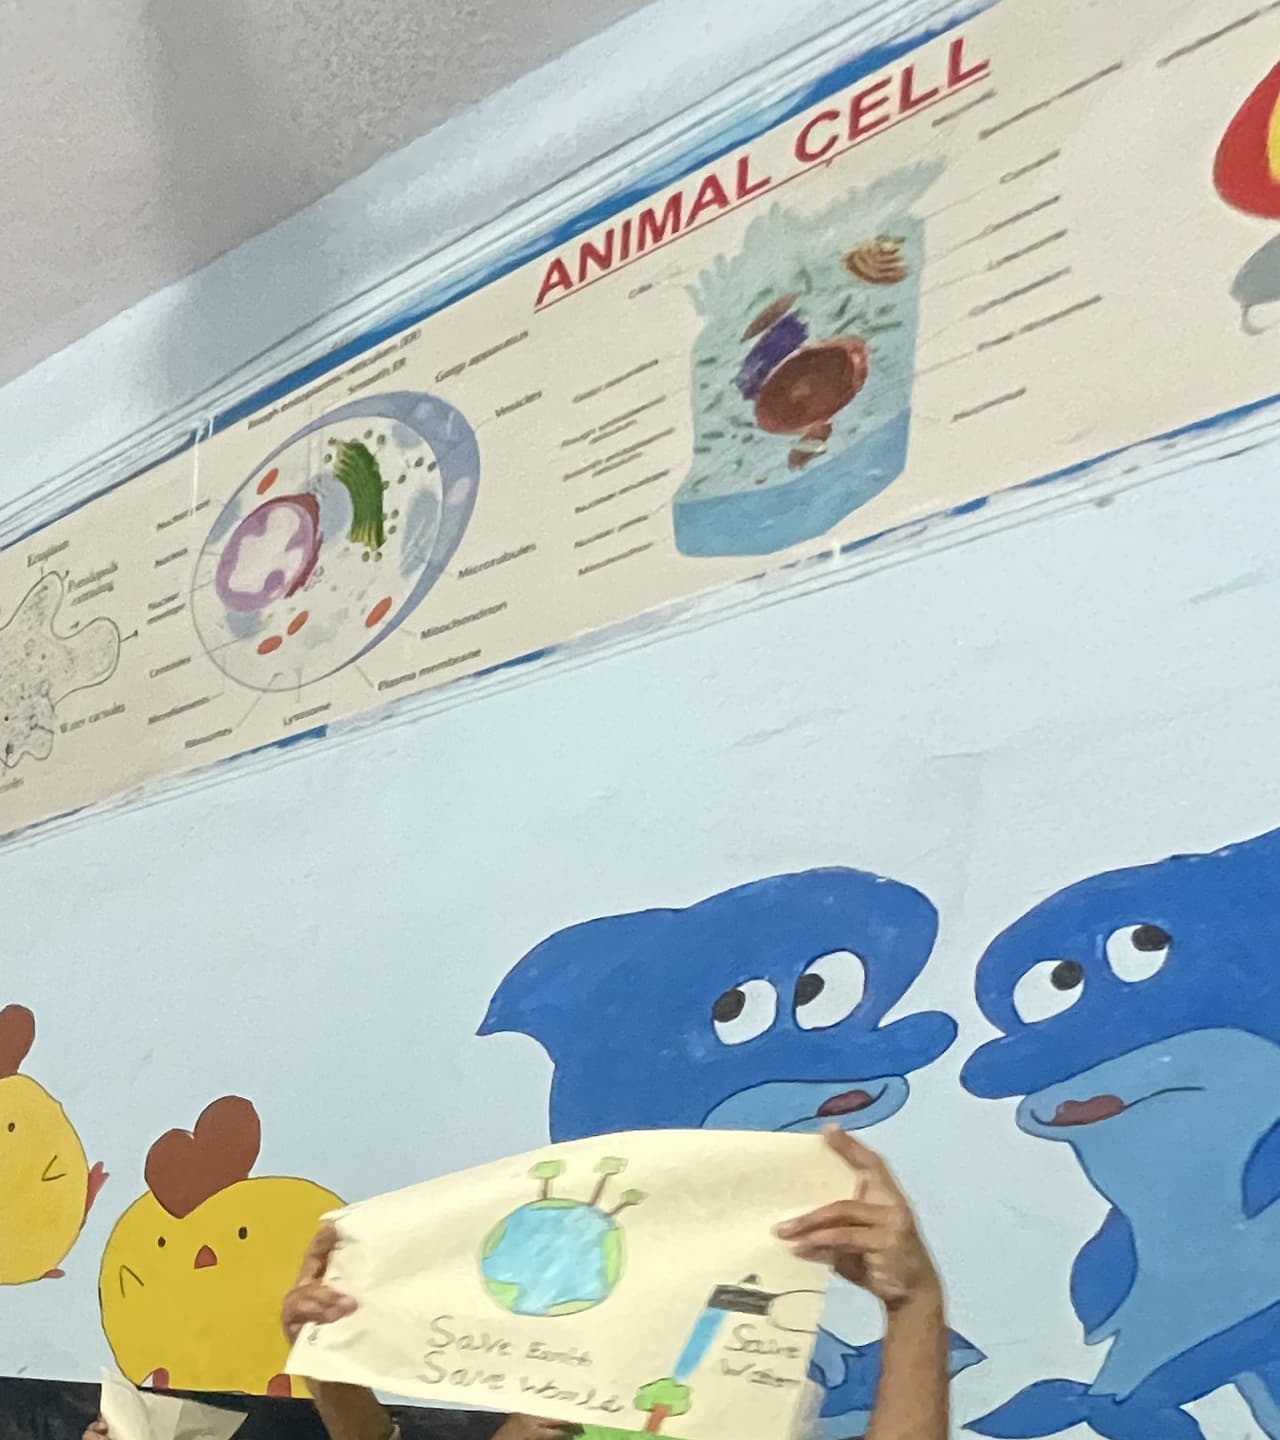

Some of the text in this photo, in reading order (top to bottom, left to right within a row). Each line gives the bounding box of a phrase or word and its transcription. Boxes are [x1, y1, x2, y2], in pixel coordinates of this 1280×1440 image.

[533, 155, 772, 308] ANIMAL
[793, 37, 991, 163] CELL
[425, 1314, 513, 1357] Save
[722, 1322, 800, 1360] Save
[415, 1350, 506, 1390] Save
